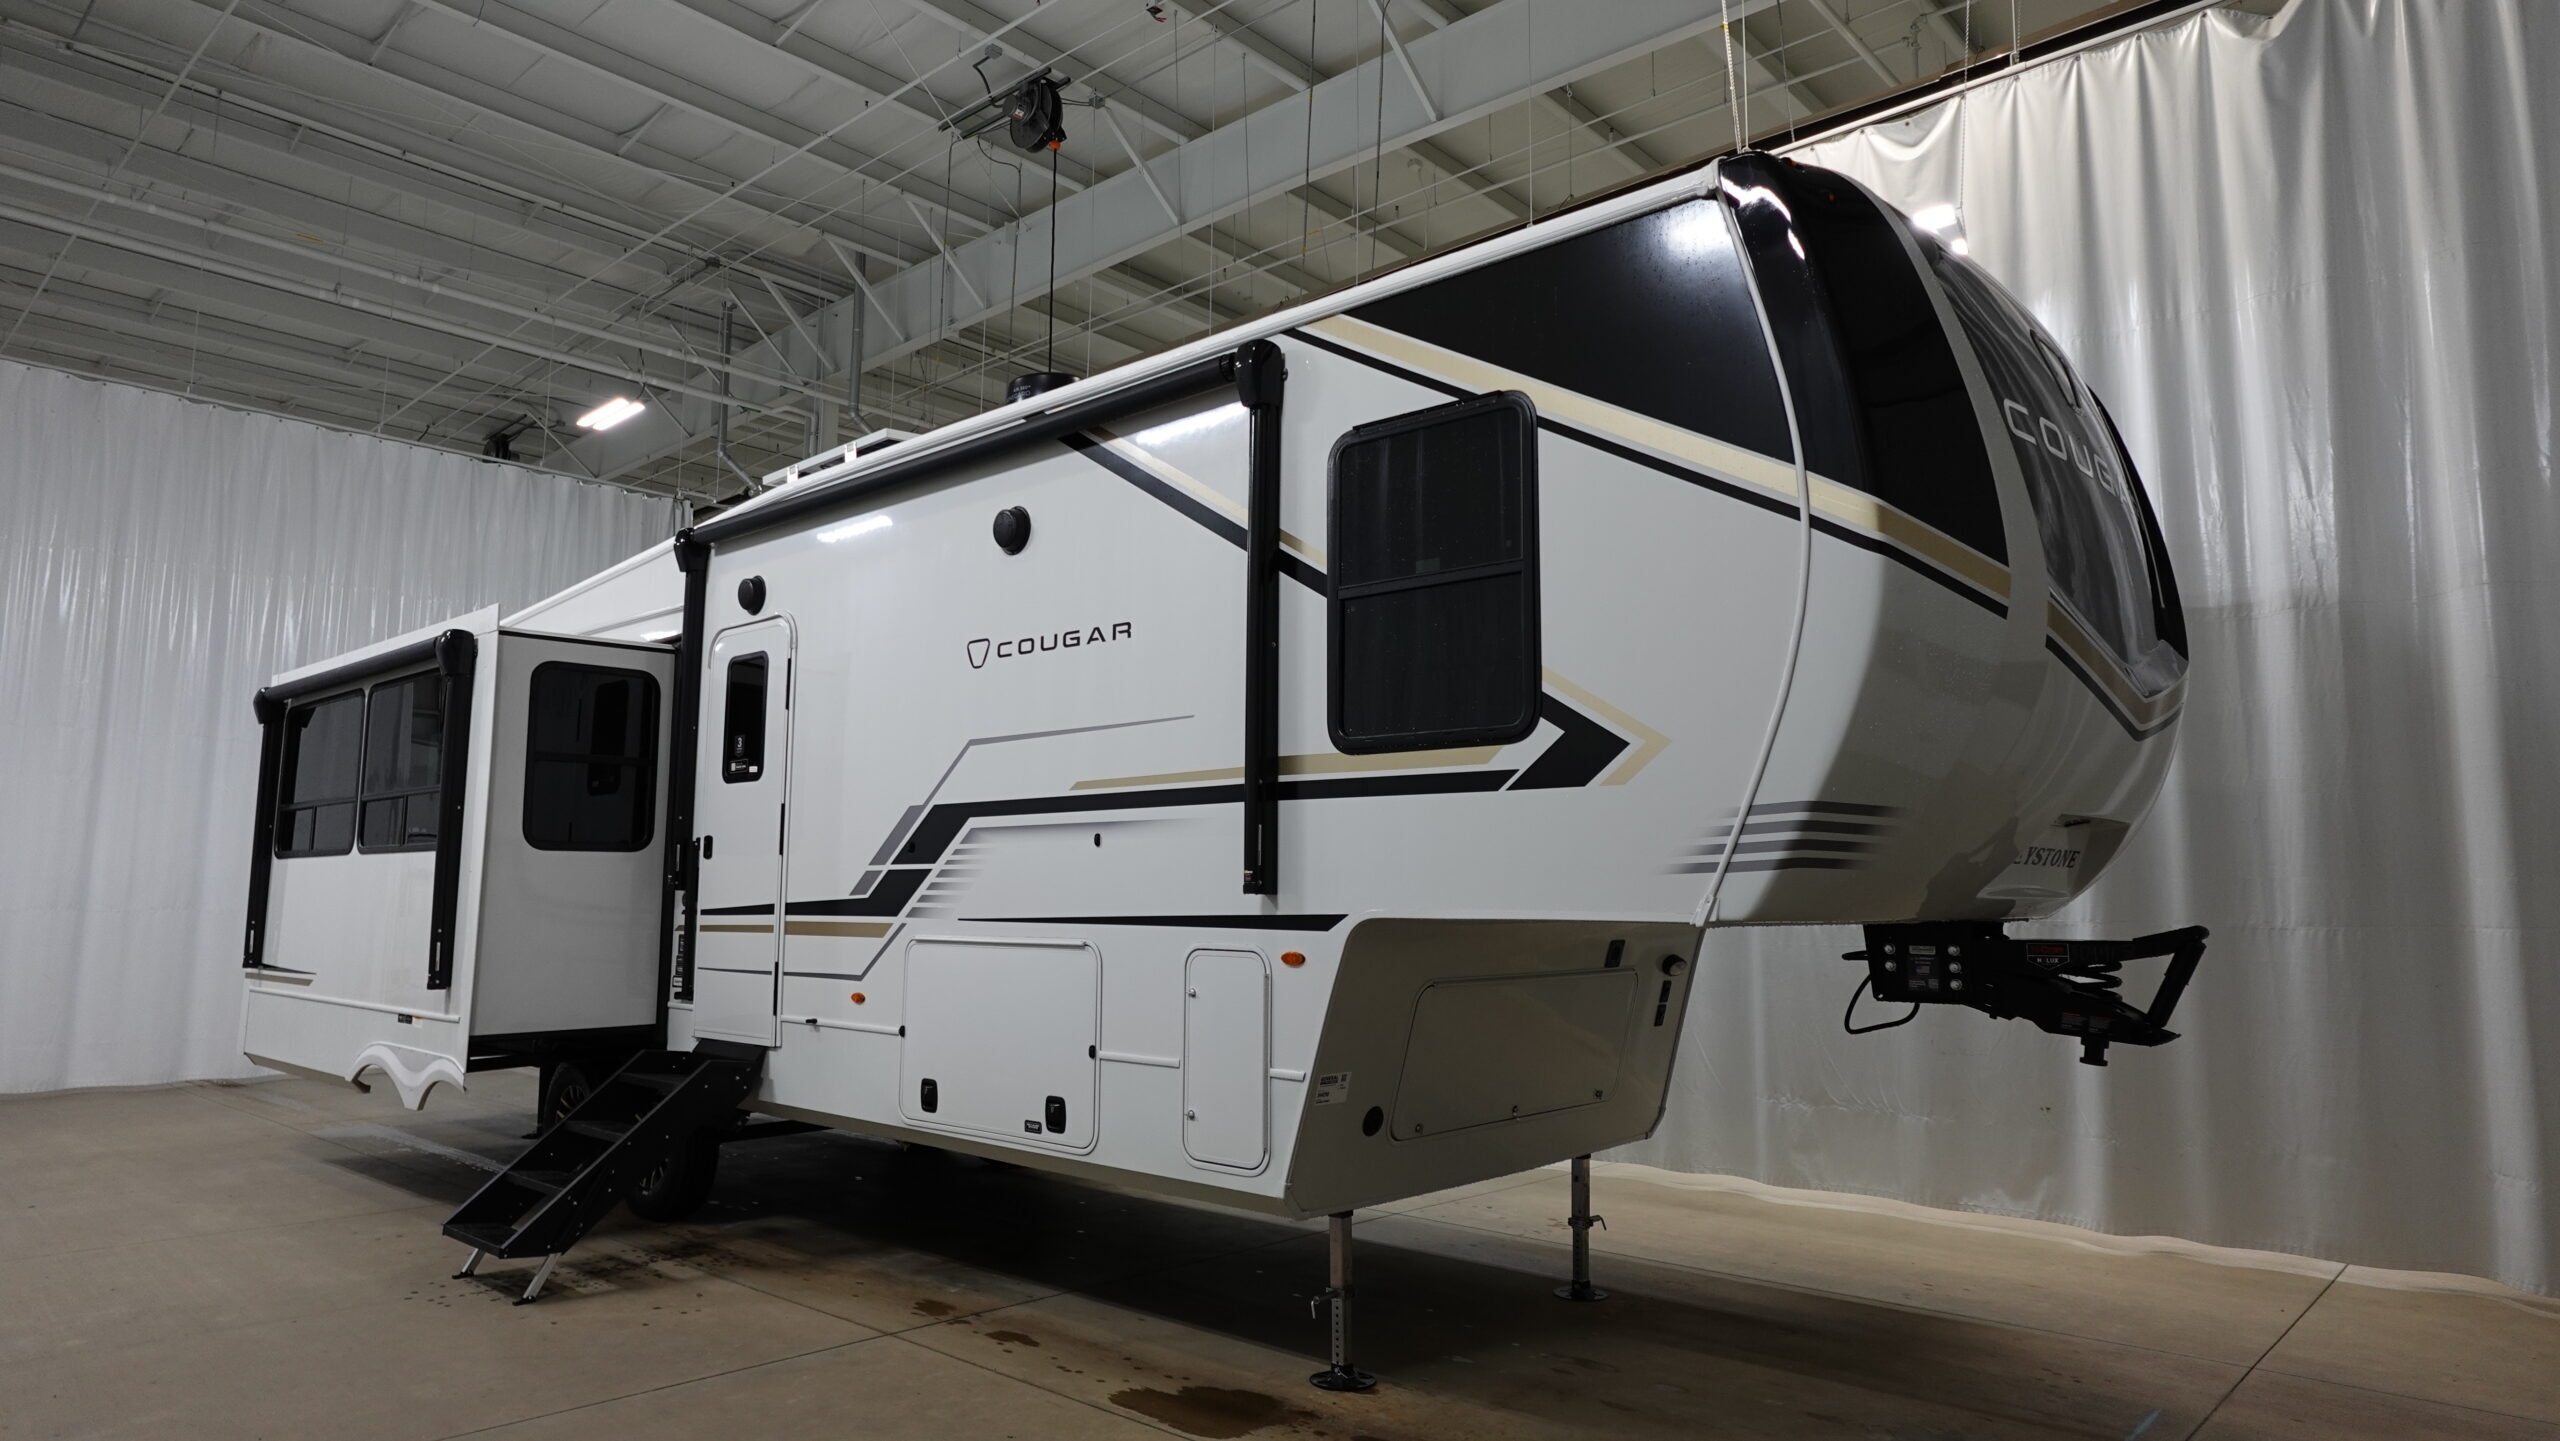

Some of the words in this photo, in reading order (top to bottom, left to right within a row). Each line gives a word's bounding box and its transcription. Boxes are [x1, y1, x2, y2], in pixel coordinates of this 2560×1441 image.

[2003, 398, 2131, 504] COUGA
[997, 621, 1132, 658] COUGAR
[2014, 846, 2080, 868] YSTONE
